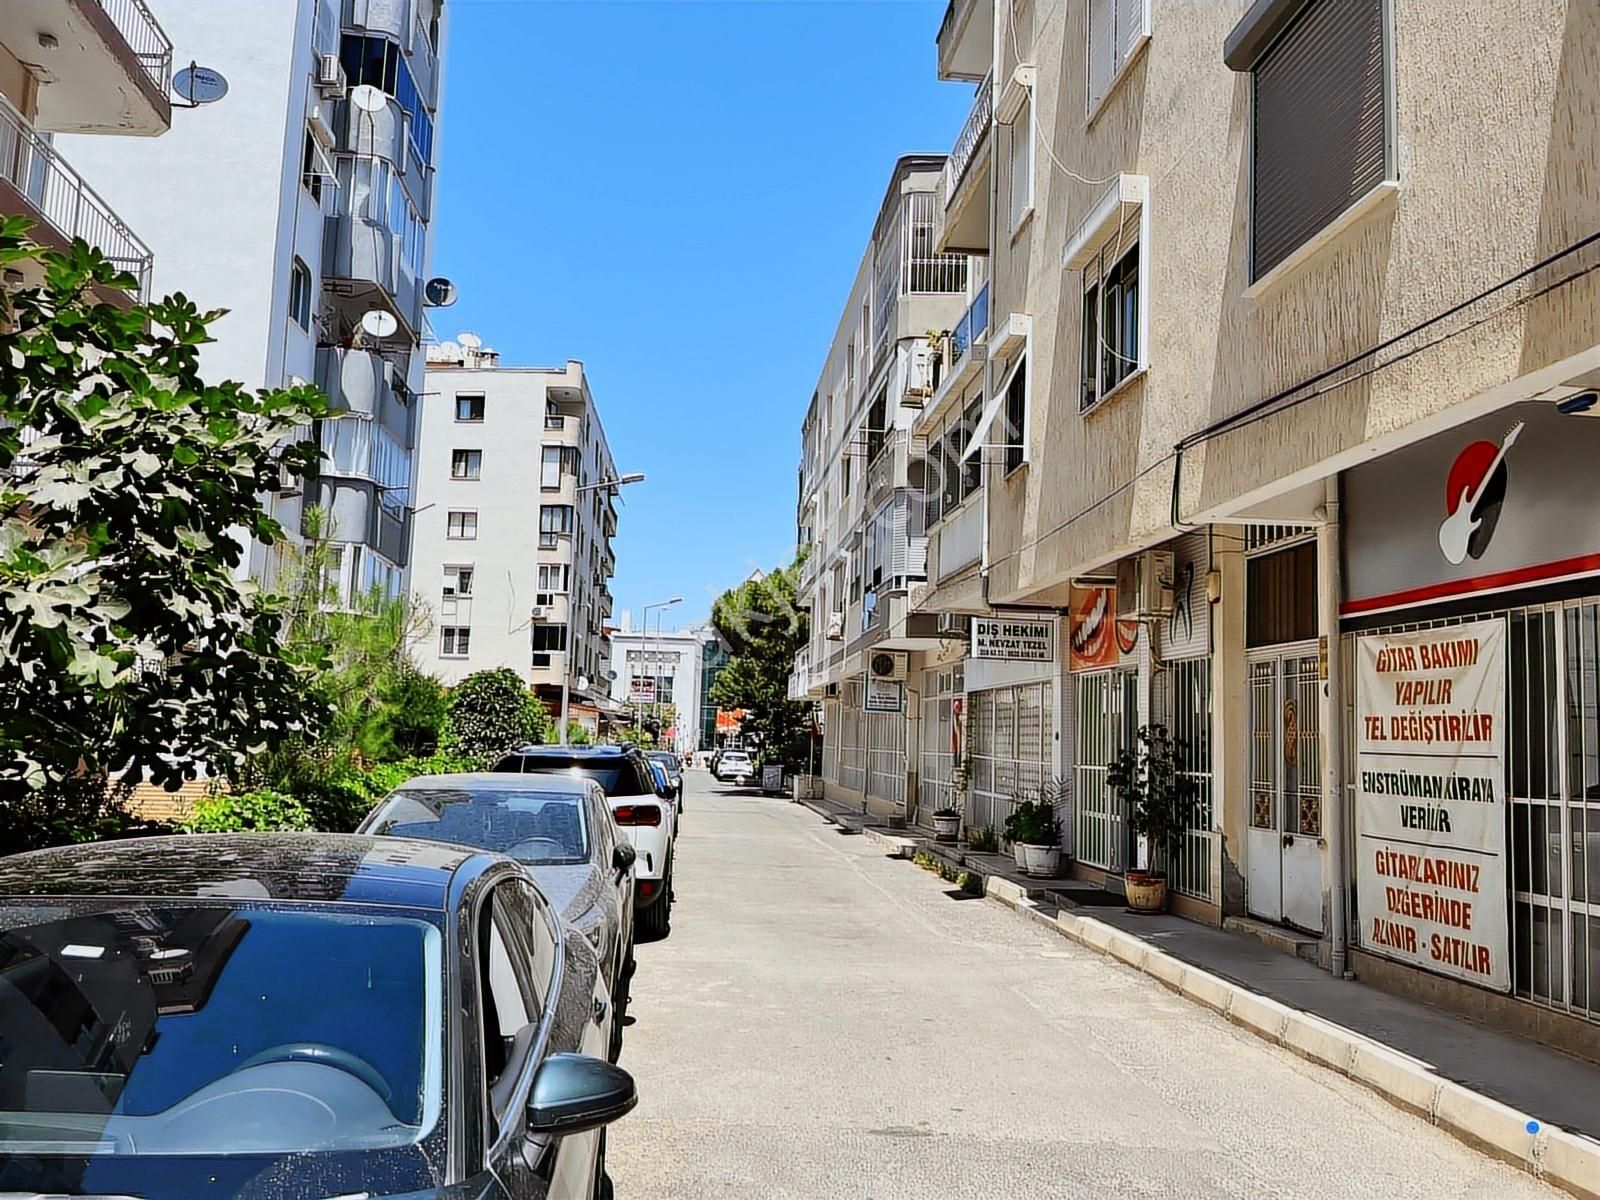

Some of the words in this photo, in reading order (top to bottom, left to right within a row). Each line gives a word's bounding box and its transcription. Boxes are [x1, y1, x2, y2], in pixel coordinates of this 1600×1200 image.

[977, 621, 999, 638] DİŞ
[1003, 623, 1048, 638] HEKİMİ
[989, 639, 1020, 649] NEVZAT
[1023, 640, 1047, 650] TEZEL
[1376, 643, 1417, 672] GİTAR
[1420, 638, 1478, 669] BAKIMI
[1395, 678, 1452, 705] YAPILIR
[1364, 716, 1387, 741] TEL
[1391, 708, 1492, 744] DEĞİŞTİRİLİR
[1362, 769, 1442, 799] ENSTRÜMAN
[1444, 771, 1494, 803] KİRAYA
[1400, 802, 1451, 832] VERİLİR
[1375, 846, 1479, 893] GİTARLARINIZ
[1372, 917, 1417, 953] ALINIR
[1431, 933, 1491, 975] SATILIR
